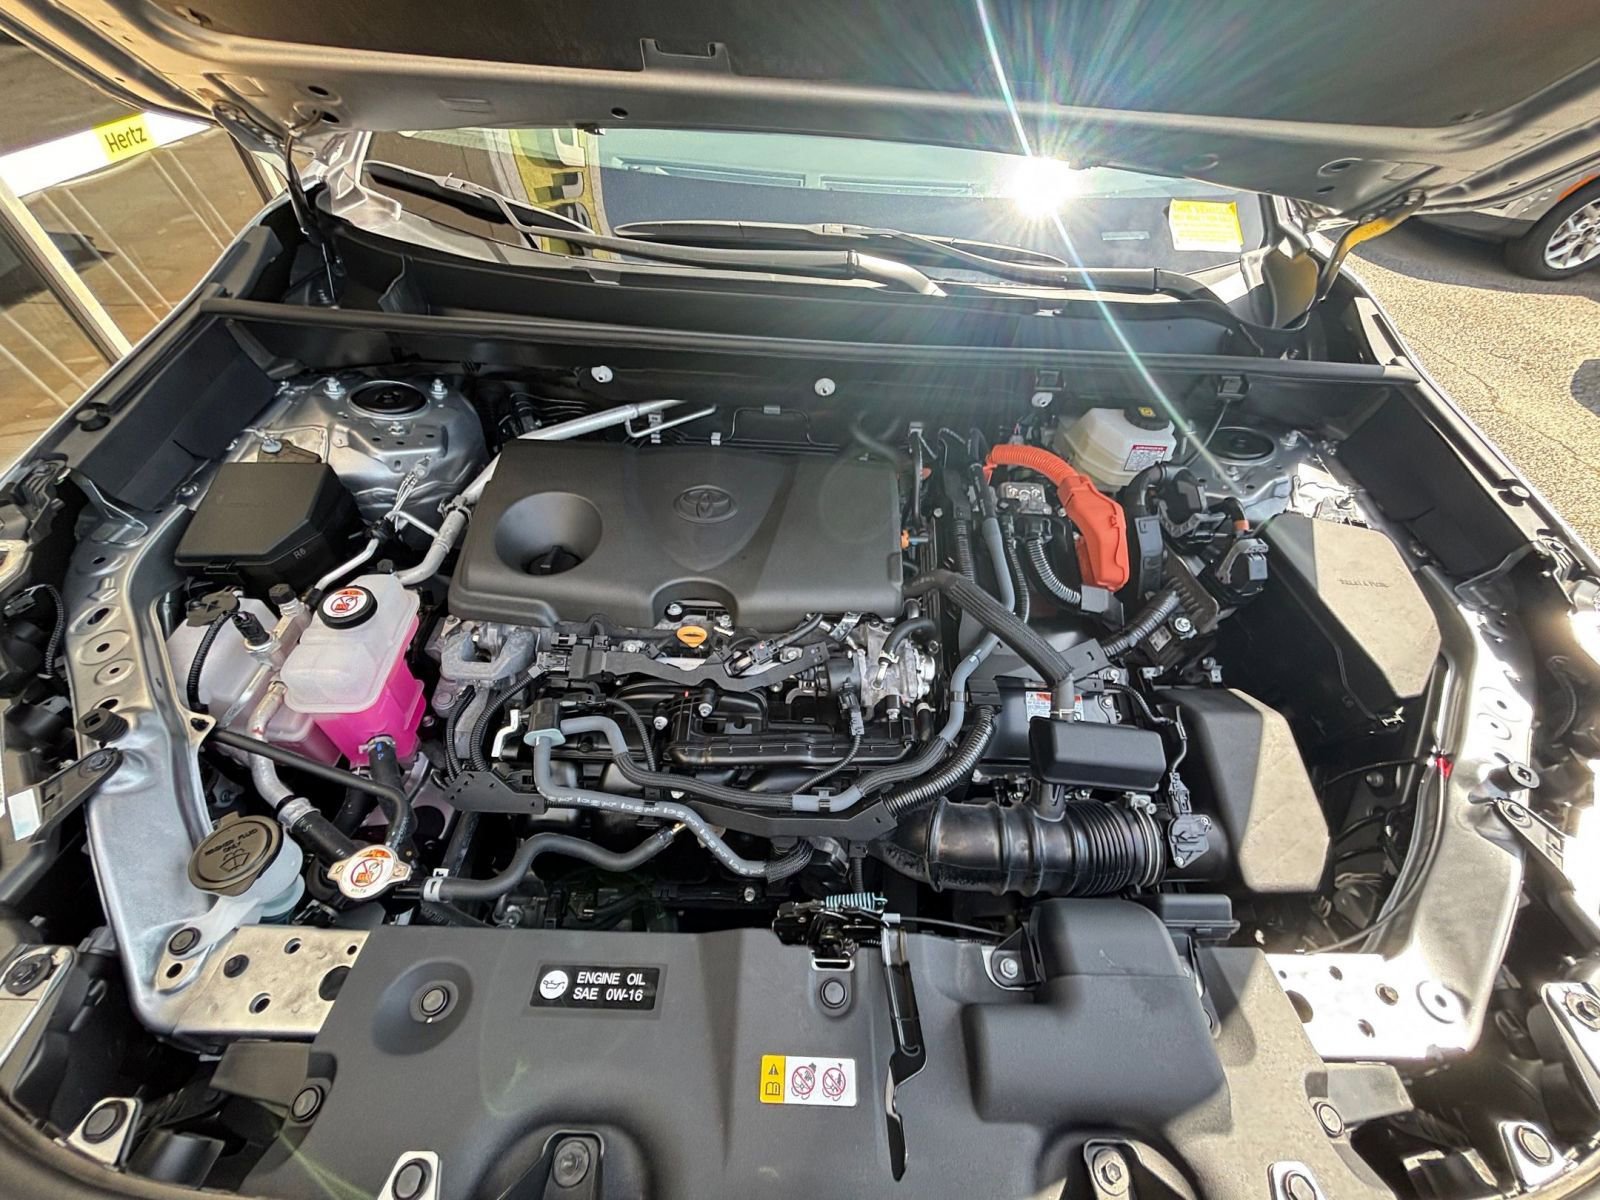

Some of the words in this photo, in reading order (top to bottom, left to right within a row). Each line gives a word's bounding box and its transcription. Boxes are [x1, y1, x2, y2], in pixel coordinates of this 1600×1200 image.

[104, 127, 147, 153] Hertz
[576, 971, 621, 985] ENGINE
[626, 973, 646, 985] OIL
[573, 987, 599, 1000] SAE
[605, 988, 644, 1001] 0W-16
